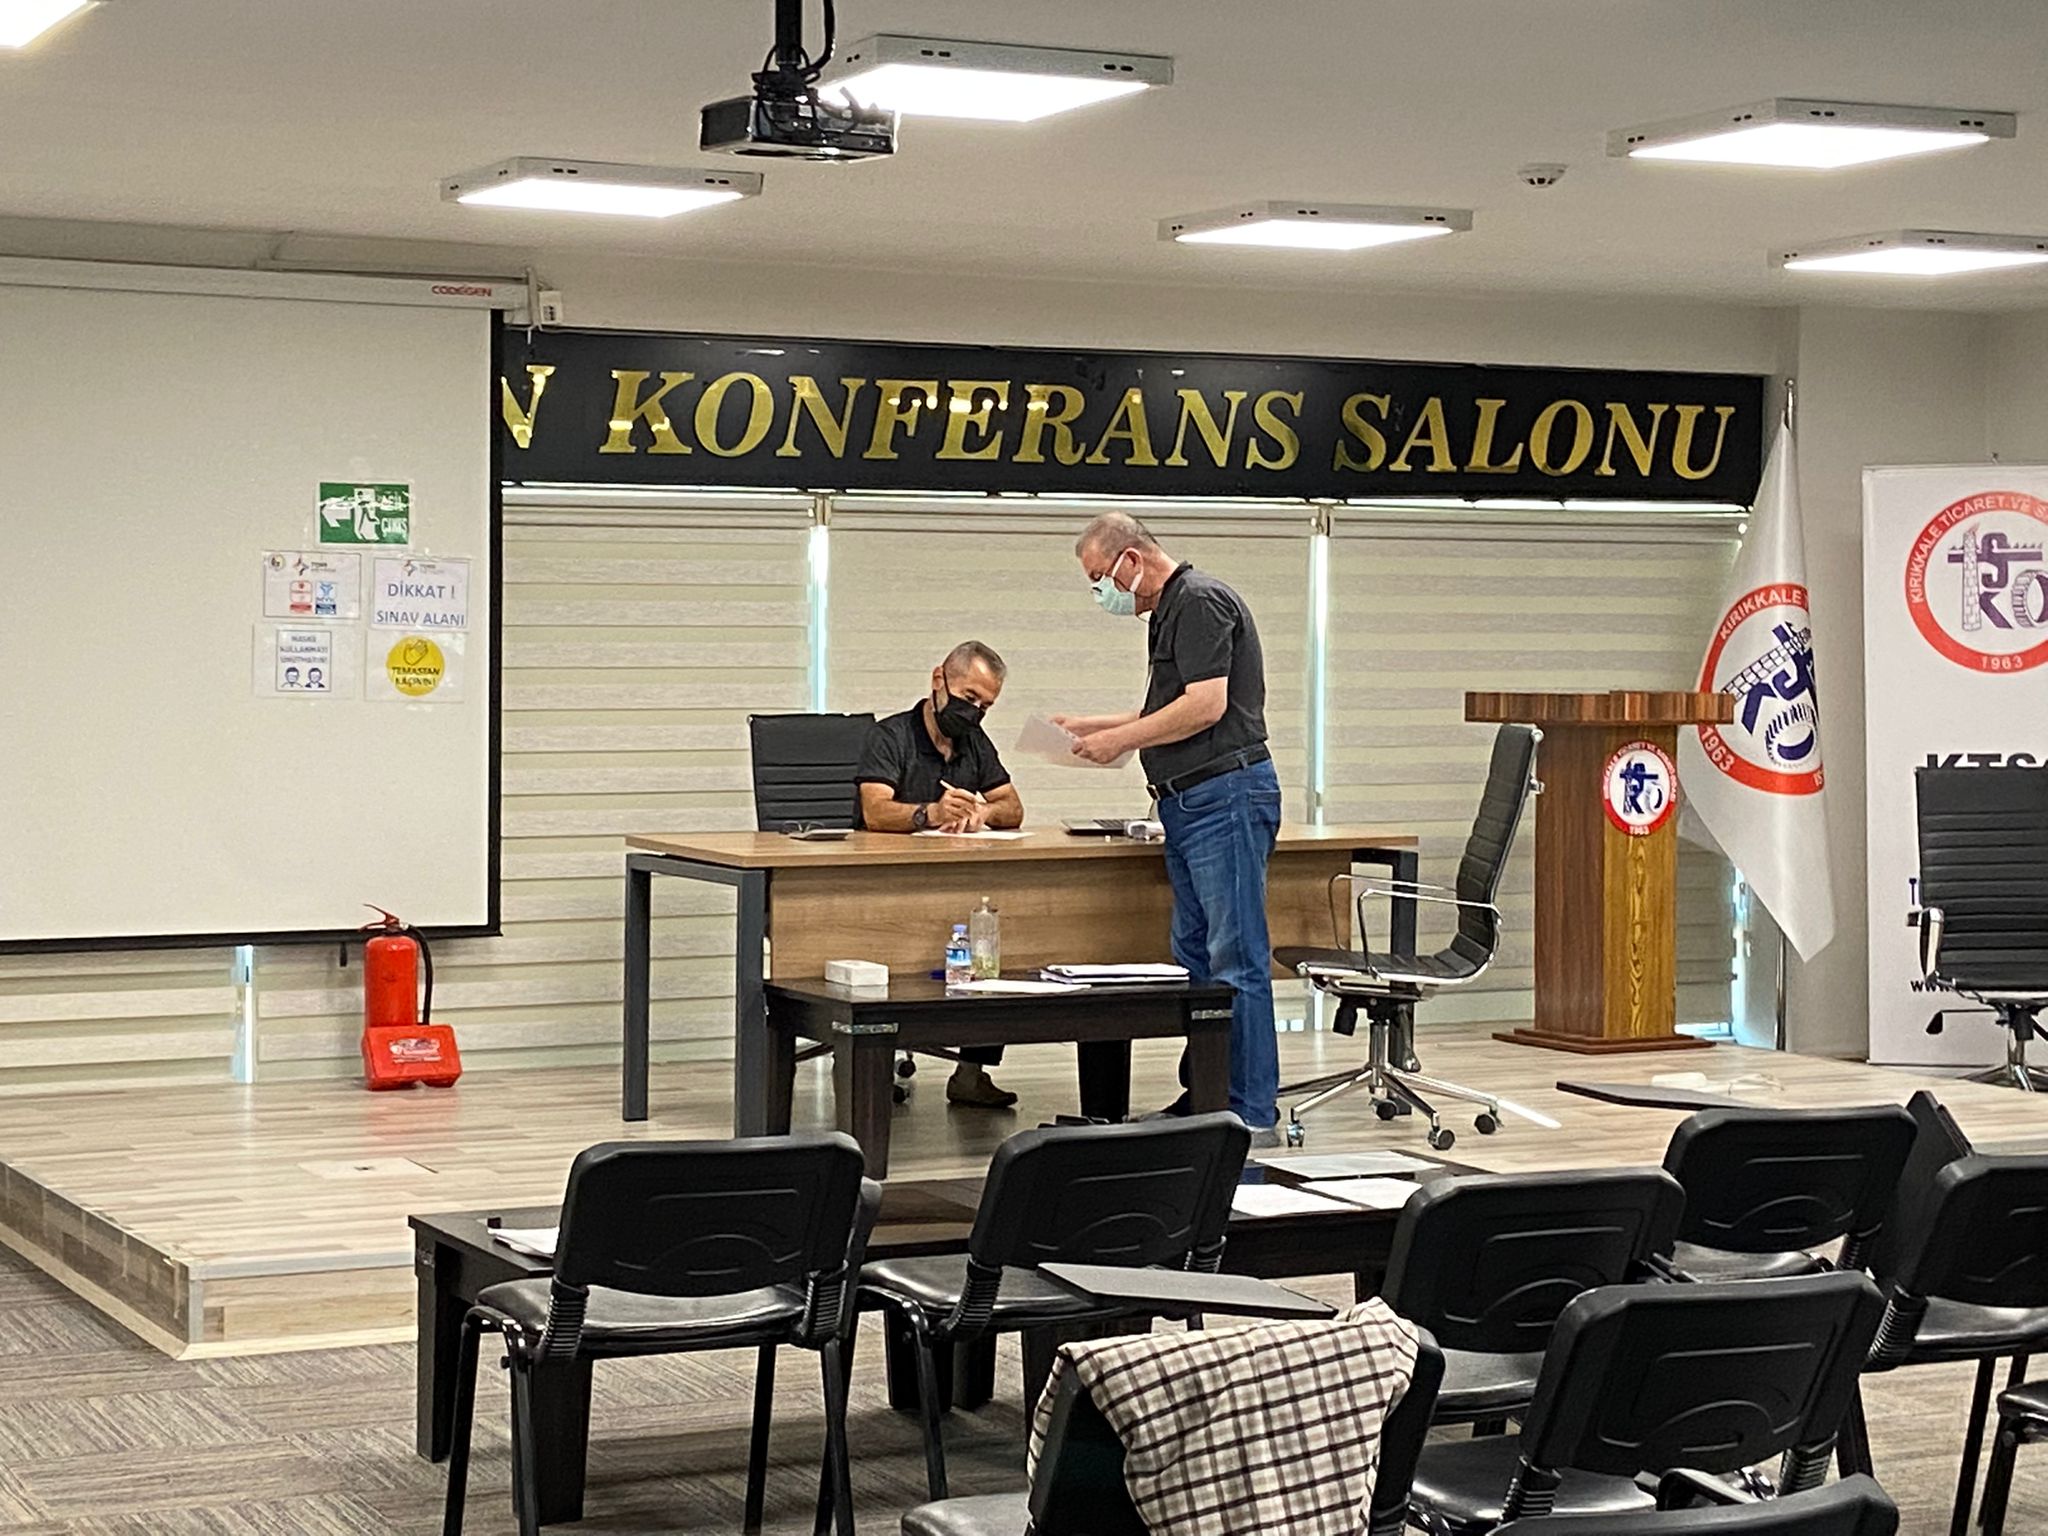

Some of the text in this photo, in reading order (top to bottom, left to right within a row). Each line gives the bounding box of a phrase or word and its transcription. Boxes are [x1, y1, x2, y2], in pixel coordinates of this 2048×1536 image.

[599, 369, 1305, 470] KONFERANS
[1333, 393, 1735, 481] SALONU
[1908, 526, 1944, 604] KIRIKKALE
[1940, 495, 2009, 527] TİCARET
[387, 580, 446, 599] DİKKAT
[377, 609, 465, 627] SINAV ALANI
[1720, 589, 1802, 640] KIRIKKALE
[1981, 656, 2023, 671] 1963
[1700, 727, 1736, 772] 1963
